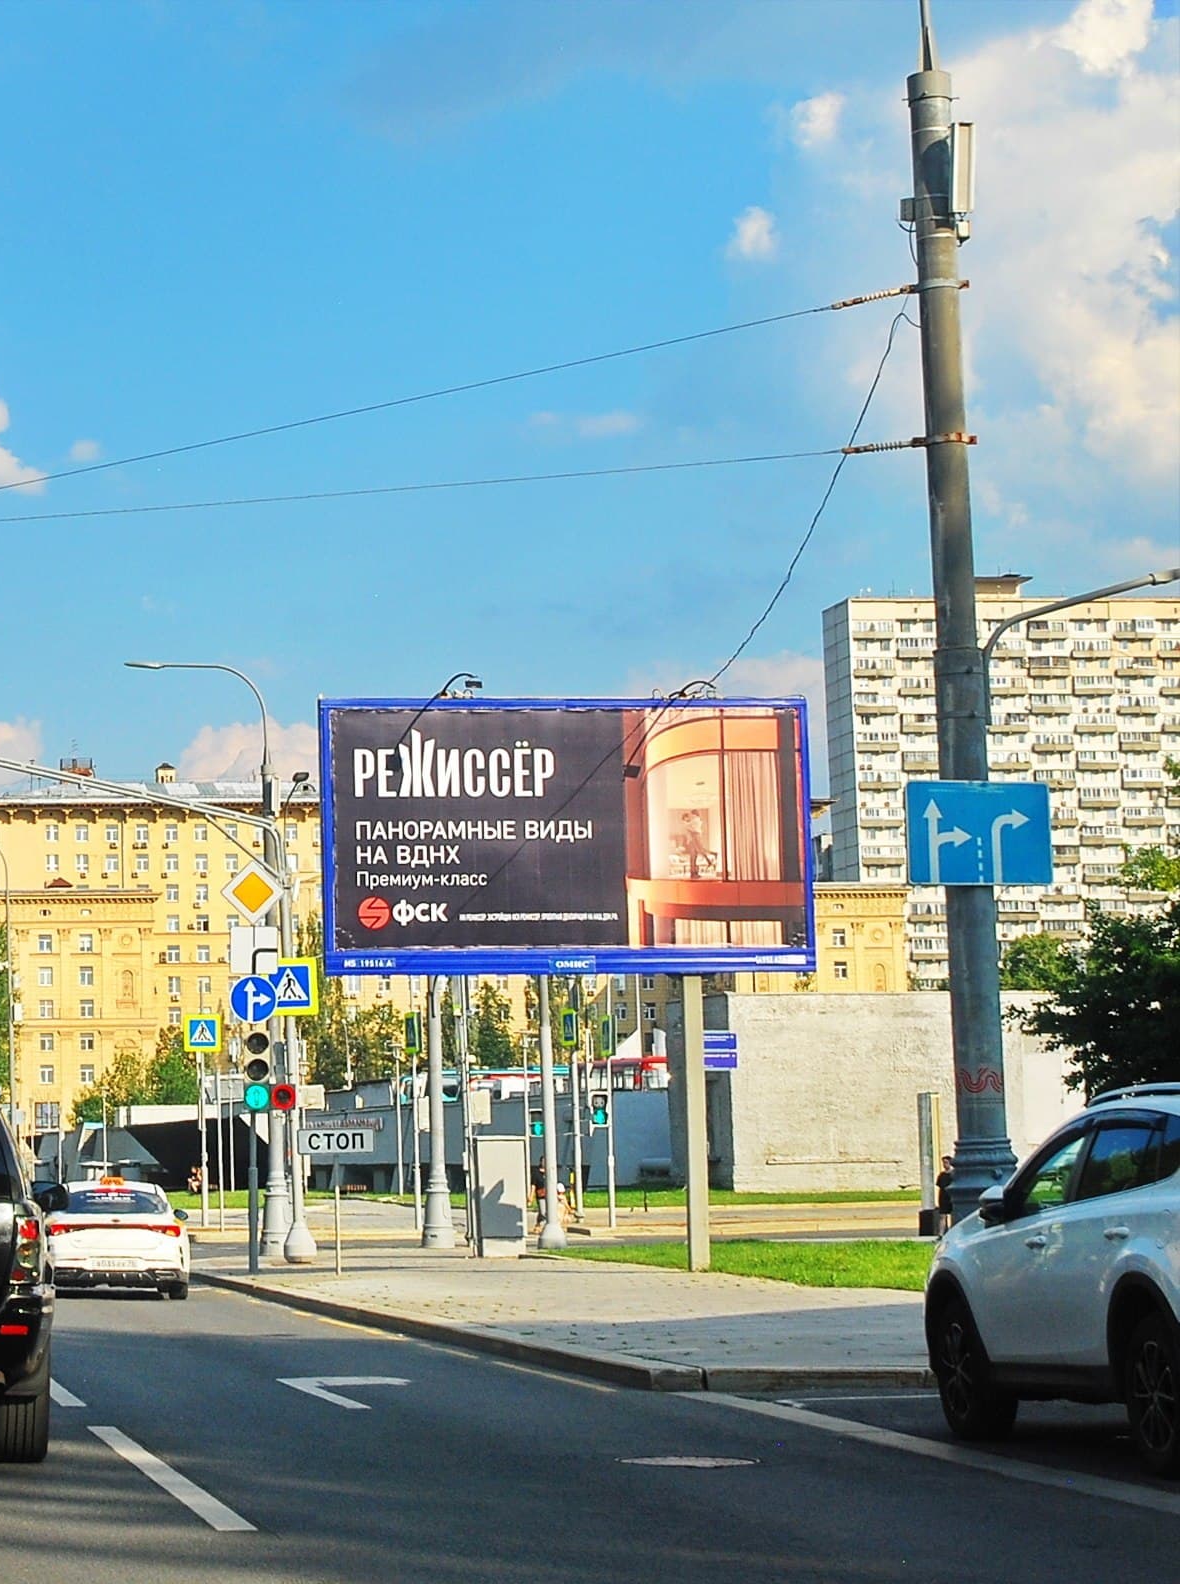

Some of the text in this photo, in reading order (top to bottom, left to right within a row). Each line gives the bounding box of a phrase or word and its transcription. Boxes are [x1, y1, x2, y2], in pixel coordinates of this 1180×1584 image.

[353, 728, 555, 797] РЕЖИССЁР
[355, 820, 594, 843] ПАНОРАМНЫЕ ВИДЫ
[356, 845, 461, 868] НА ВДНХ
[356, 871, 488, 890] Премиум-класс
[392, 899, 449, 926] ФСК
[308, 1132, 364, 1150] СТОП
